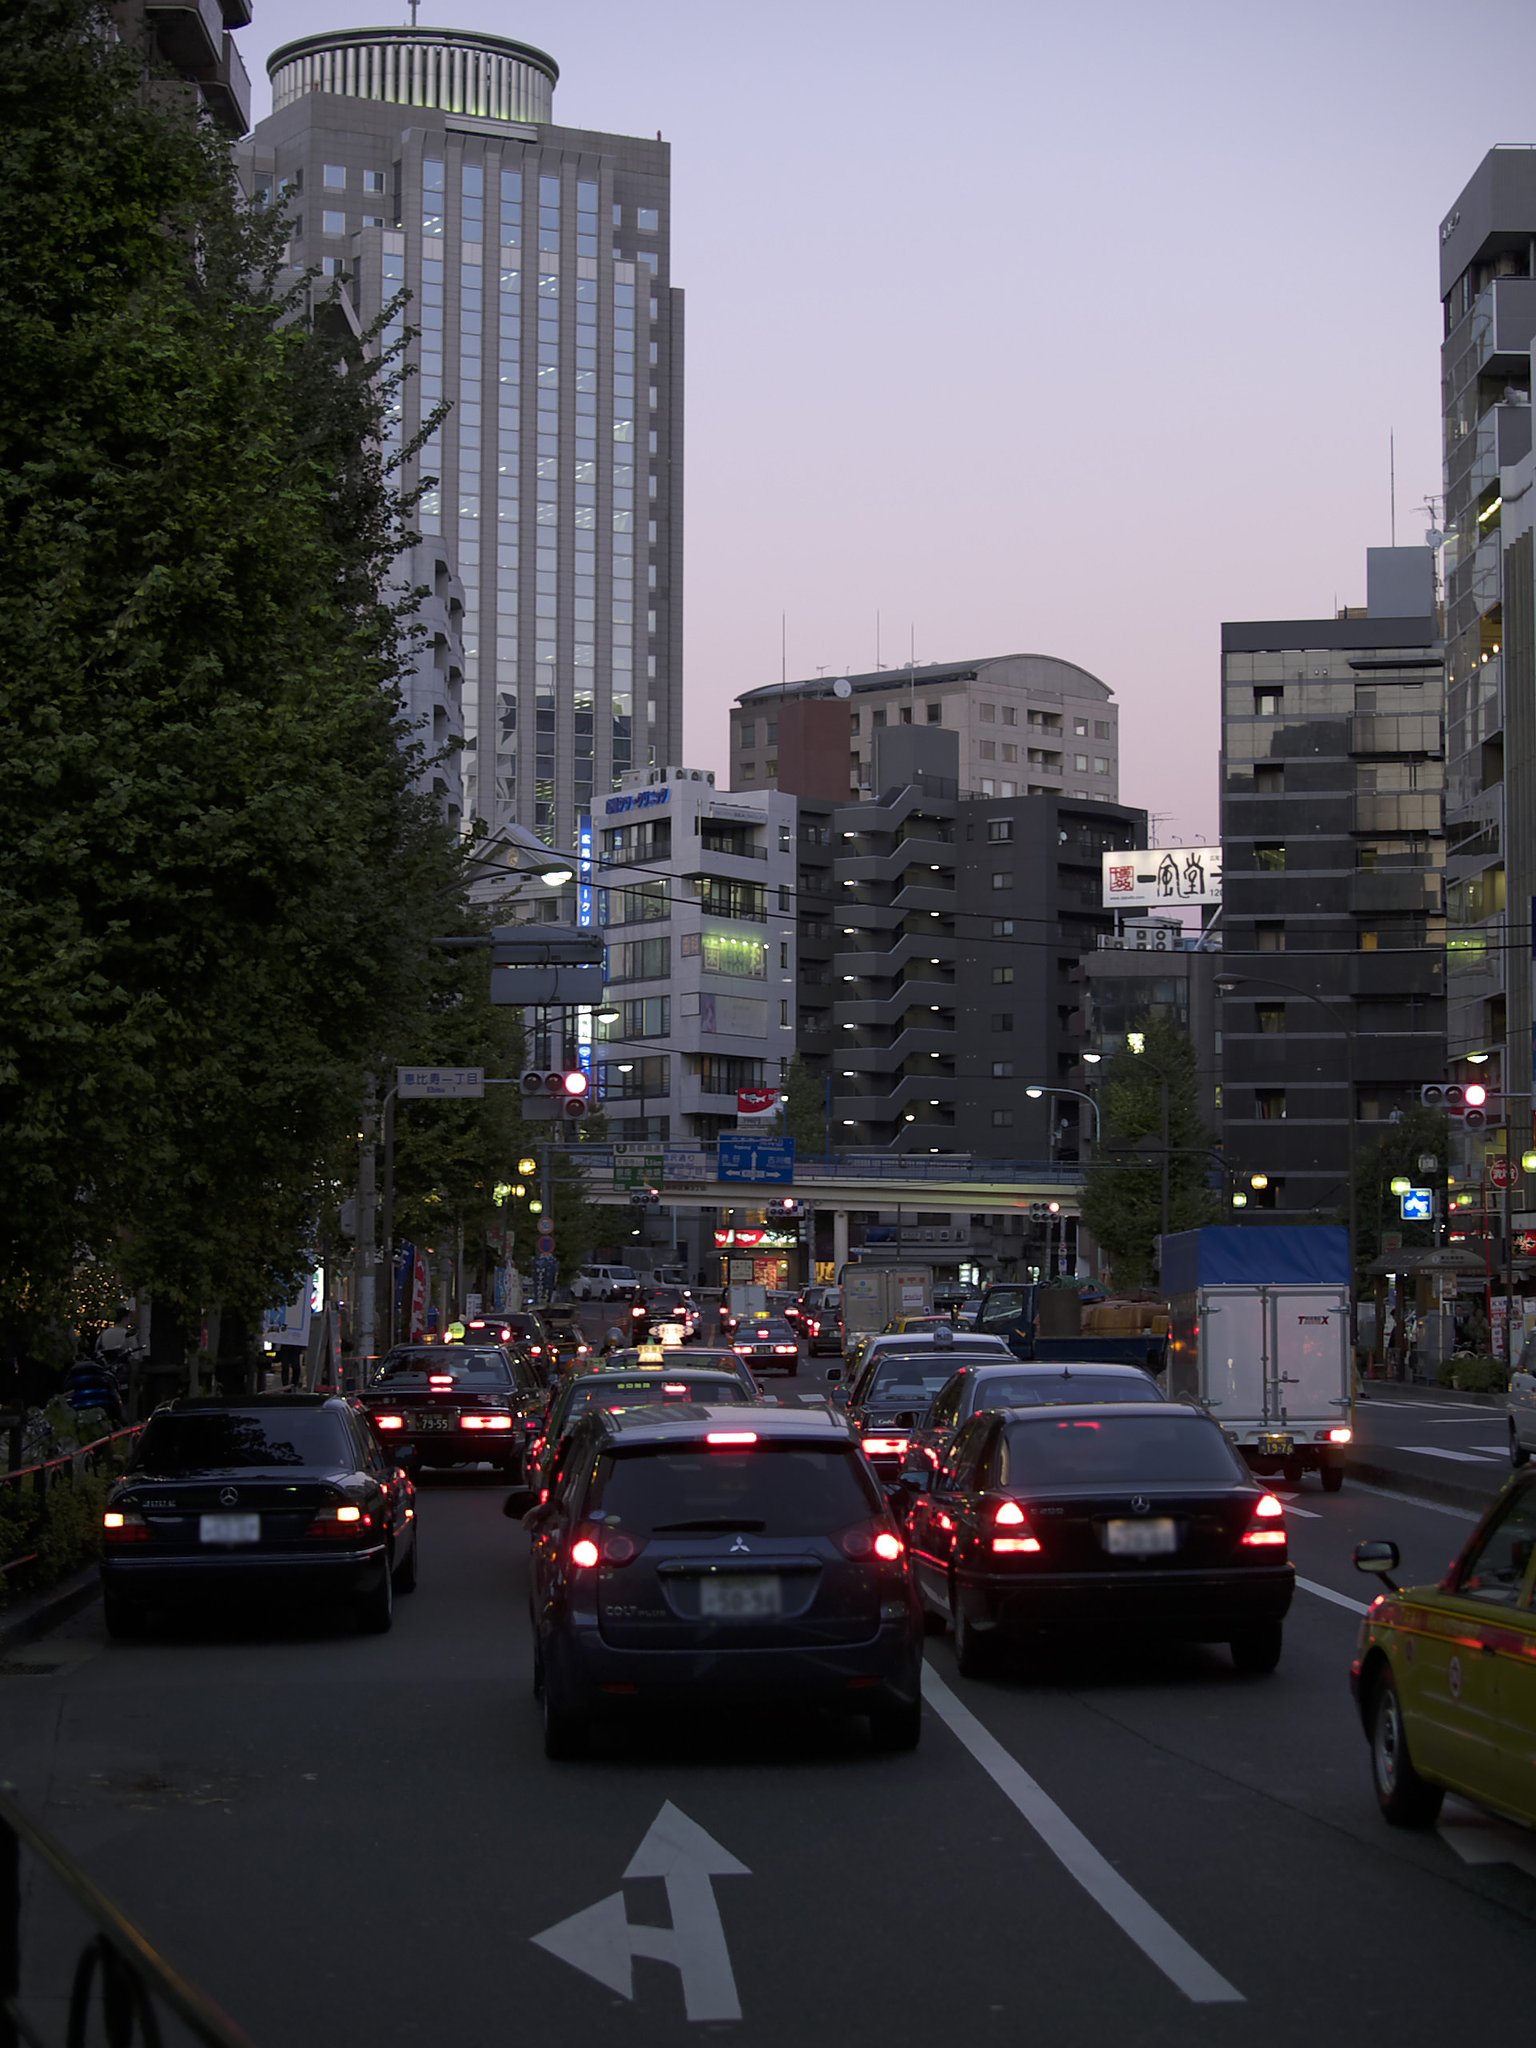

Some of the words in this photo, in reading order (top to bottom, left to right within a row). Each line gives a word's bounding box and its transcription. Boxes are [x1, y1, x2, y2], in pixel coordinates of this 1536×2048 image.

[405, 1072, 478, 1085] 恵比寿一丁目
[422, 1419, 448, 1429] 79-55
[1267, 1443, 1293, 1455] 19-76
[606, 1605, 637, 1616] COLT
